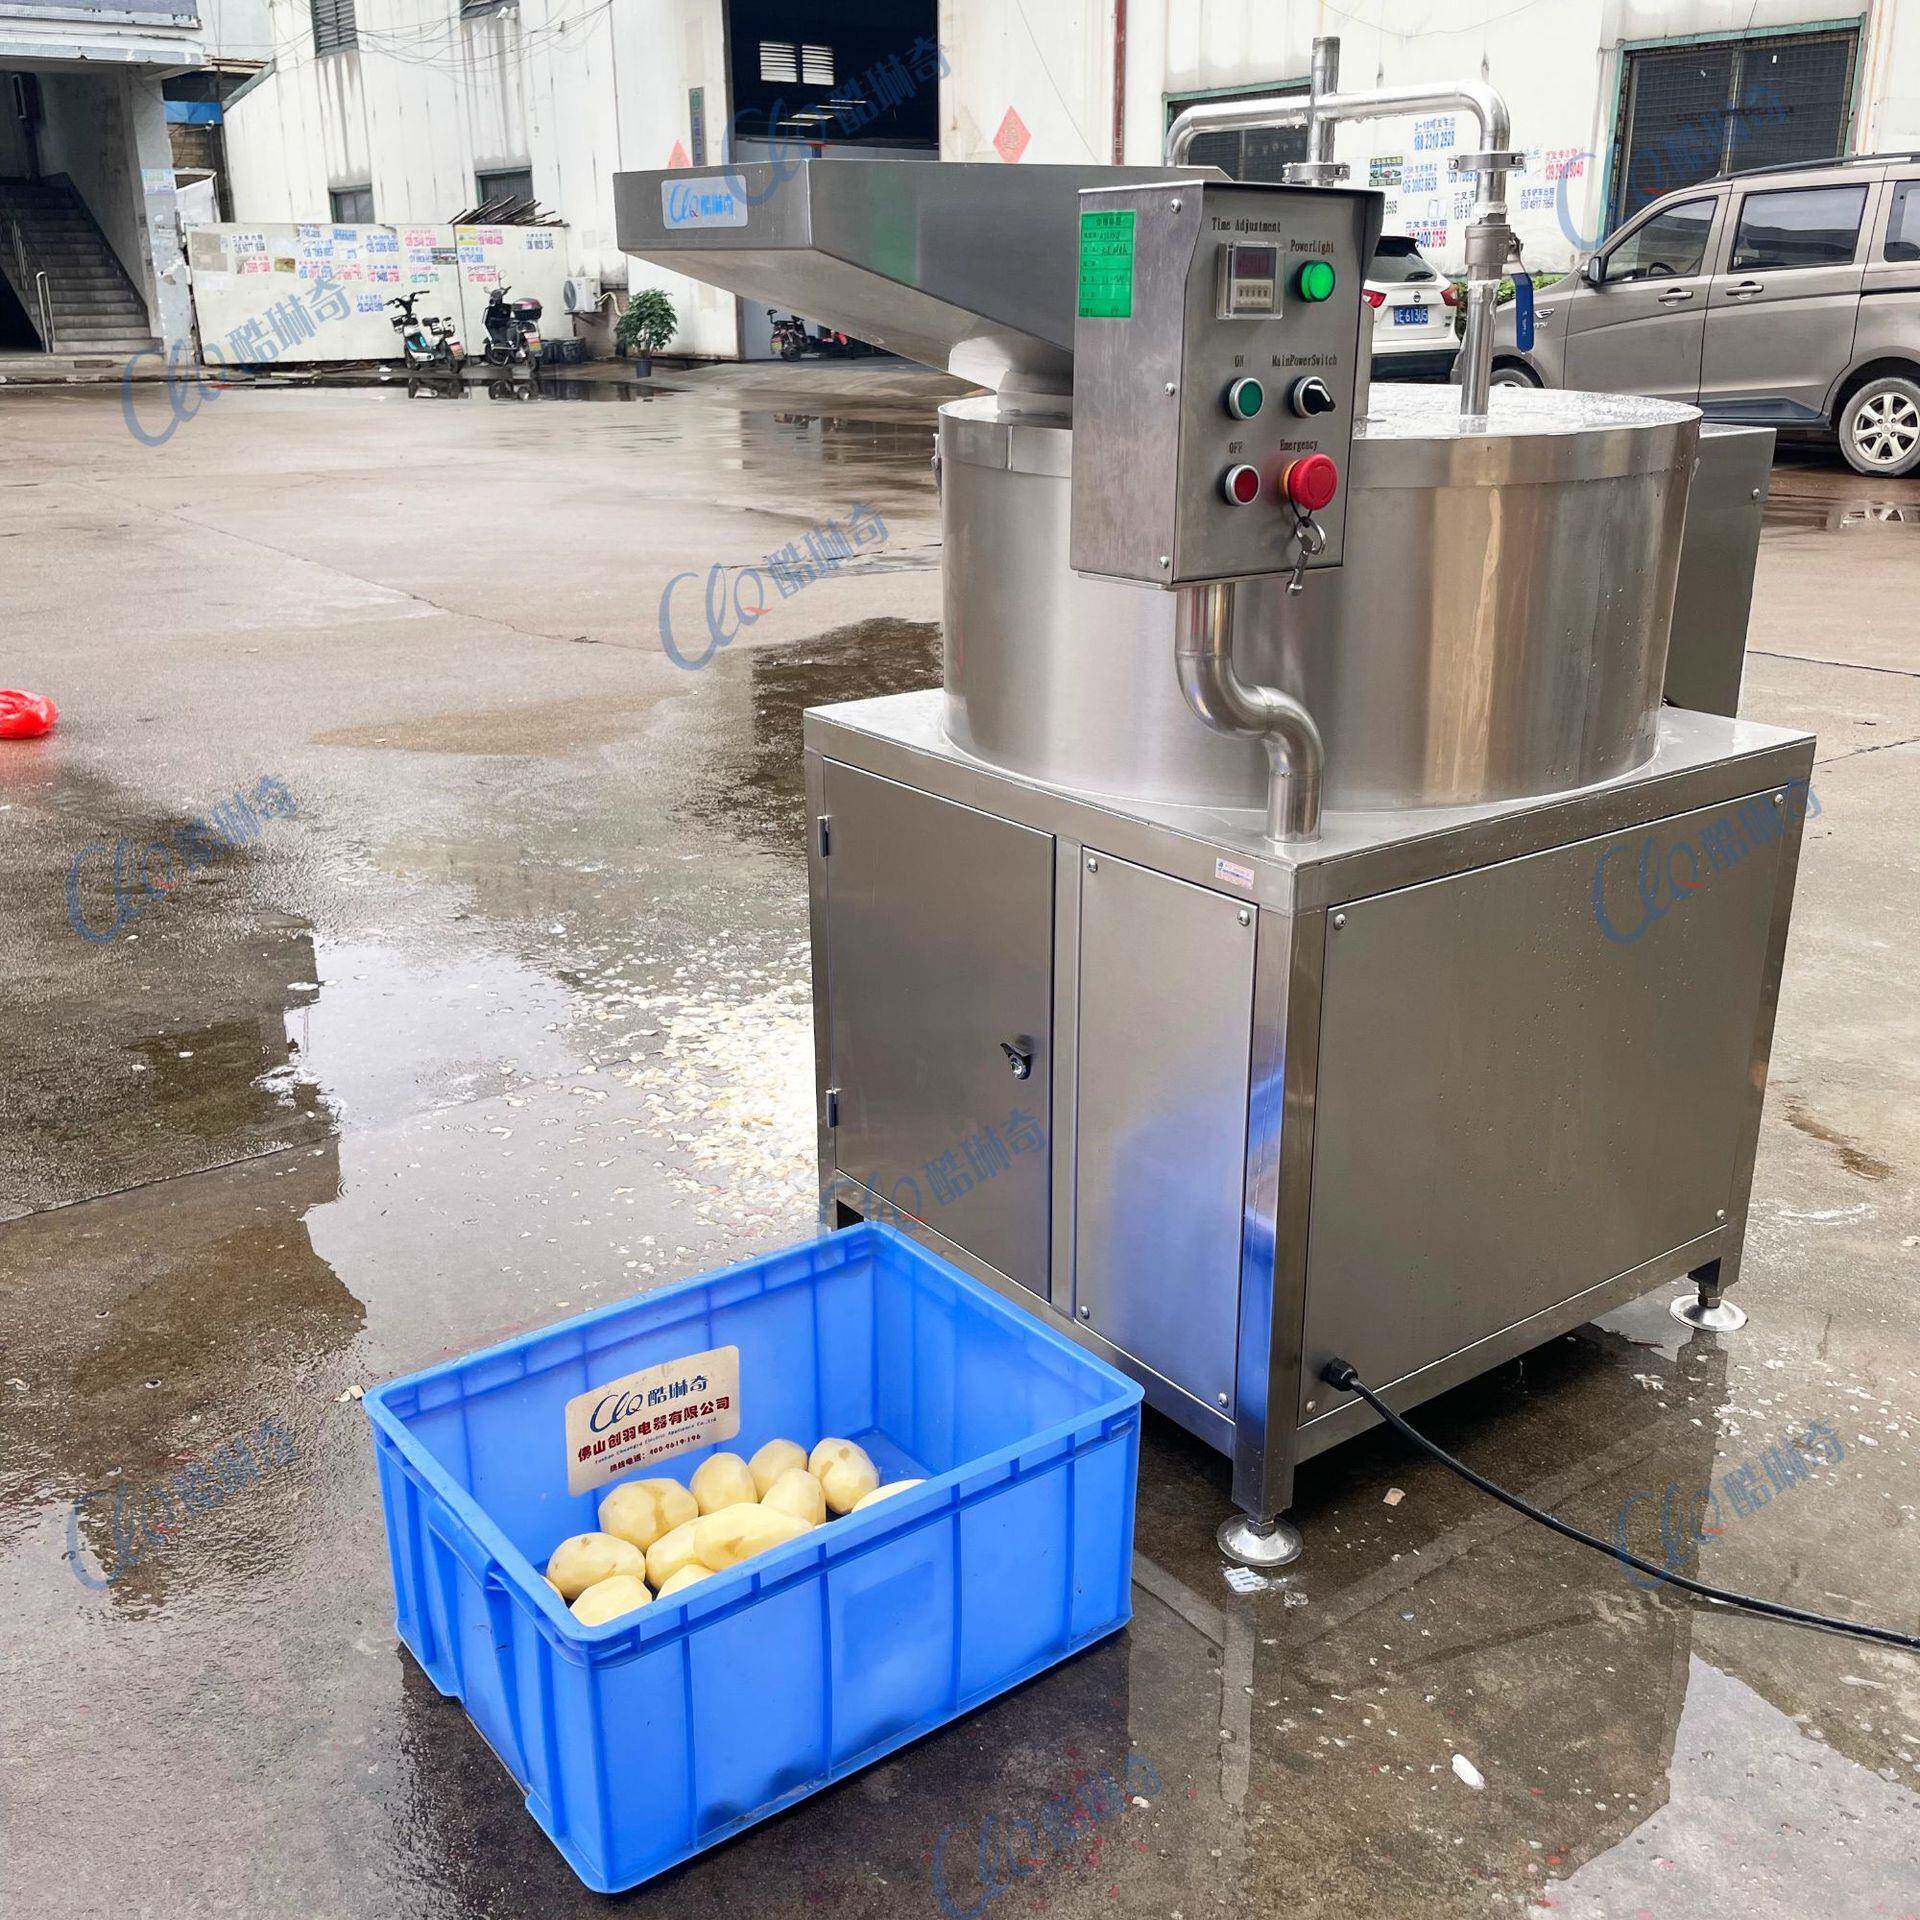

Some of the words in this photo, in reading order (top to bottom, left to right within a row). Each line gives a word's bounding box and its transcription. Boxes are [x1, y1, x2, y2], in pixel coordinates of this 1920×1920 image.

[1212, 217, 1231, 231] Time
[1235, 218, 1281, 234] Adjustment
[1290, 239, 1334, 255] PowerLight
[1234, 355, 1245, 368] ON
[1272, 354, 1338, 368] MainPowerSwitch
[1228, 440, 1244, 454] OFF
[1279, 438, 1318, 452] Emergency
[647, 1374, 709, 1407] 酷琳奇
[577, 1396, 730, 1462] 佛山创羽电器有限公司
